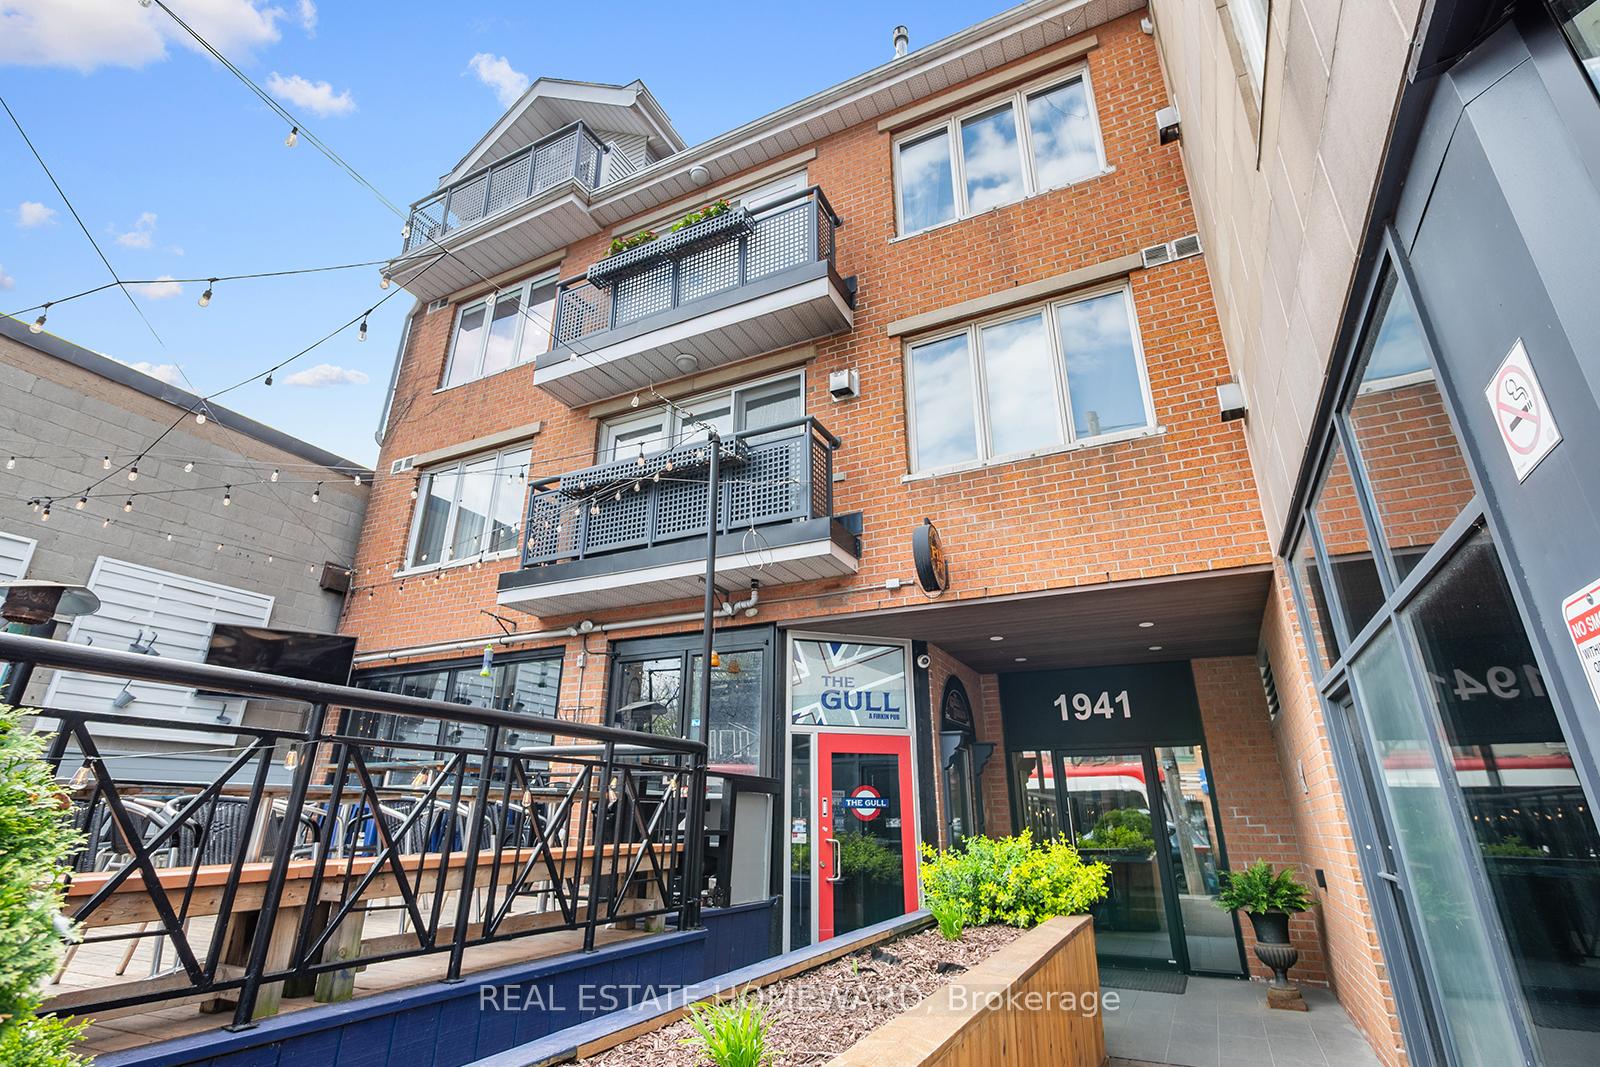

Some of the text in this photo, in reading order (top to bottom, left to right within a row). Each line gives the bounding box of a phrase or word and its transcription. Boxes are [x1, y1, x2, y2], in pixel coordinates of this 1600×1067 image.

[1572, 620, 1588, 639] NO
[821, 675, 855, 688] THE
[821, 689, 900, 712] GULL
[1053, 690, 1133, 721] 1941
[845, 799, 887, 807] THE GULL
